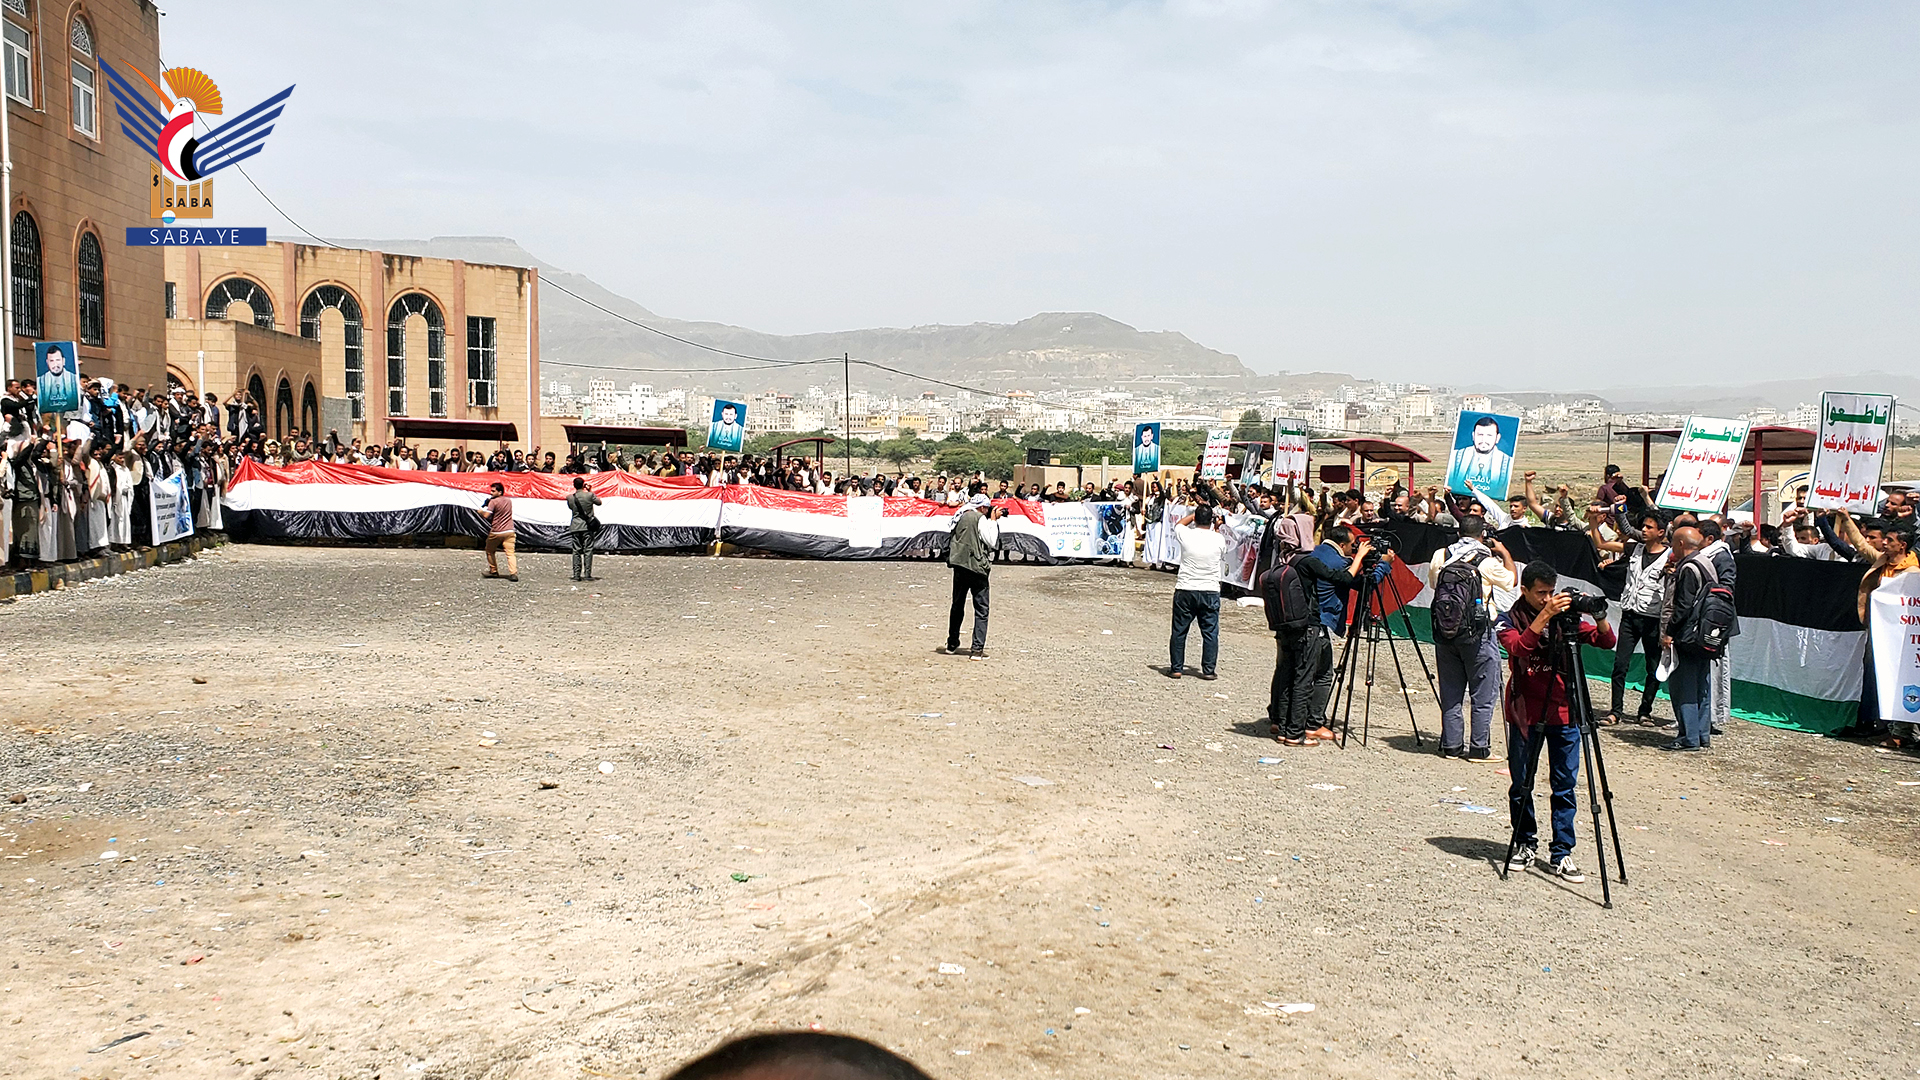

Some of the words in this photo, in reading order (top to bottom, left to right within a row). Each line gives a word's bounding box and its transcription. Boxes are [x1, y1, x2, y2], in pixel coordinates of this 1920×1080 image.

[1826, 401, 1888, 426] قاطعوا
[1279, 423, 1306, 437] قاطعوا
[1687, 423, 1744, 442] قاطعوا
[1853, 436, 1882, 456] البضائع
[1708, 451, 1736, 467] البضائع
[1697, 469, 1703, 480] و
[1844, 460, 1850, 475] و
